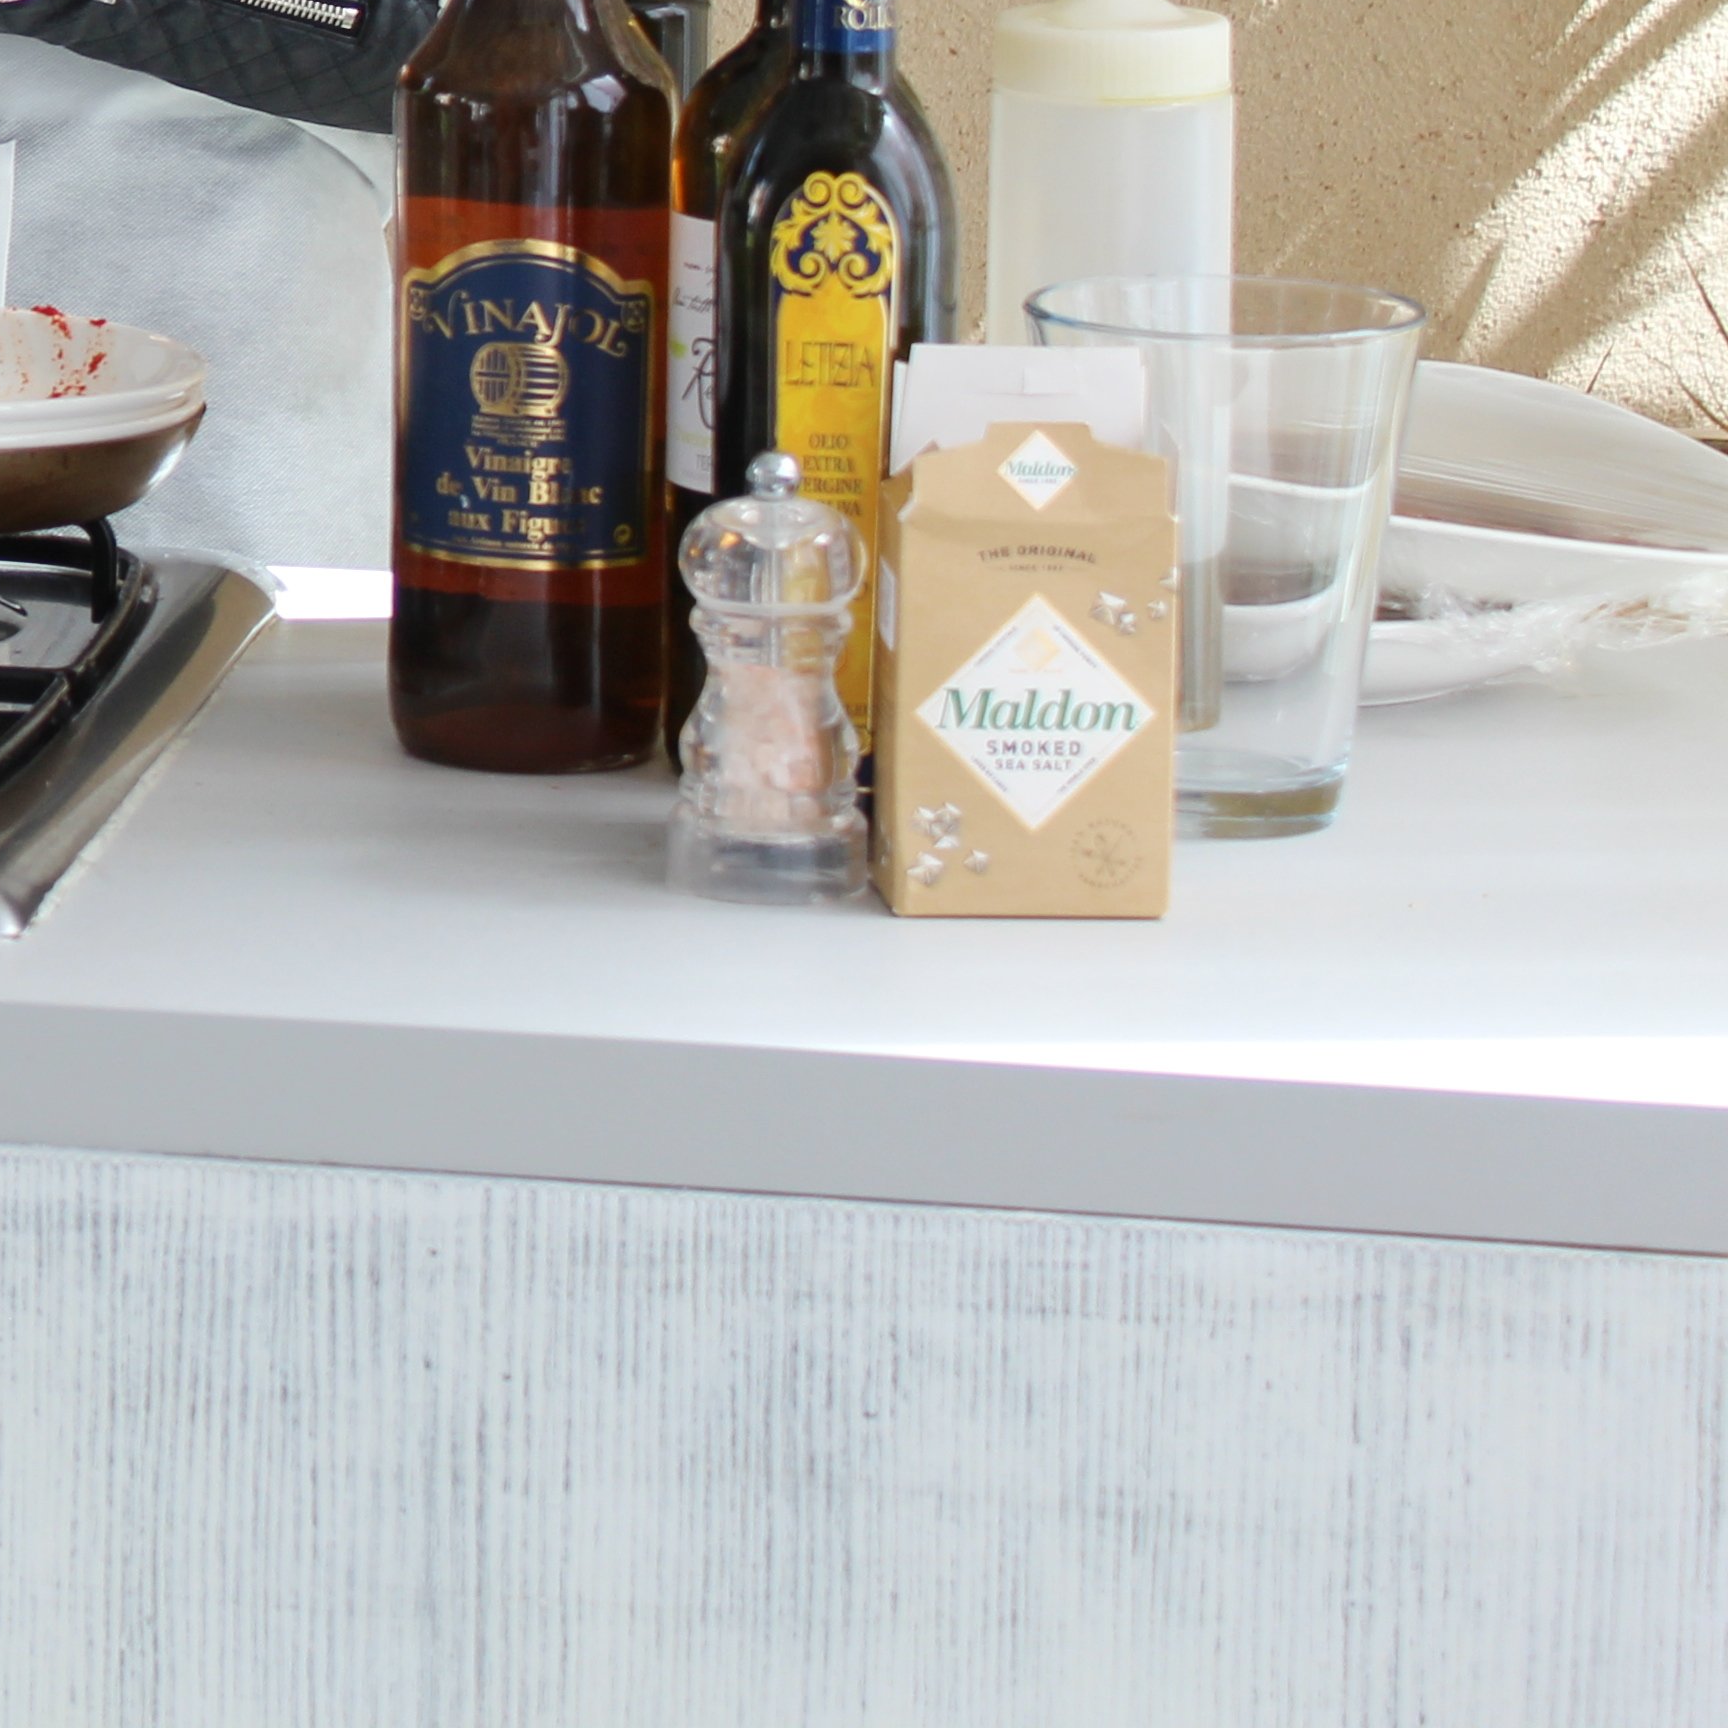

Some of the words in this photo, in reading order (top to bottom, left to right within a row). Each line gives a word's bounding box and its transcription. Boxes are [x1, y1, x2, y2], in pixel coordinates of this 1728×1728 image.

[421, 289, 628, 358] VINAJOL
[784, 340, 875, 387] LETIZIA
[808, 433, 848, 450] OLIO
[464, 443, 574, 481] Vinaigre
[802, 455, 856, 473] EXTRA
[1005, 460, 1076, 477] Maldon
[435, 471, 463, 496] de
[471, 475, 518, 504] Vin
[448, 509, 491, 532] aux
[976, 546, 1010, 563] THE
[1016, 544, 1097, 565] ORIGINAL
[935, 686, 1140, 732] Maldon
[985, 738, 1082, 757] SMOKED
[994, 758, 1026, 771] SEA
[1032, 758, 1073, 771] SALT
